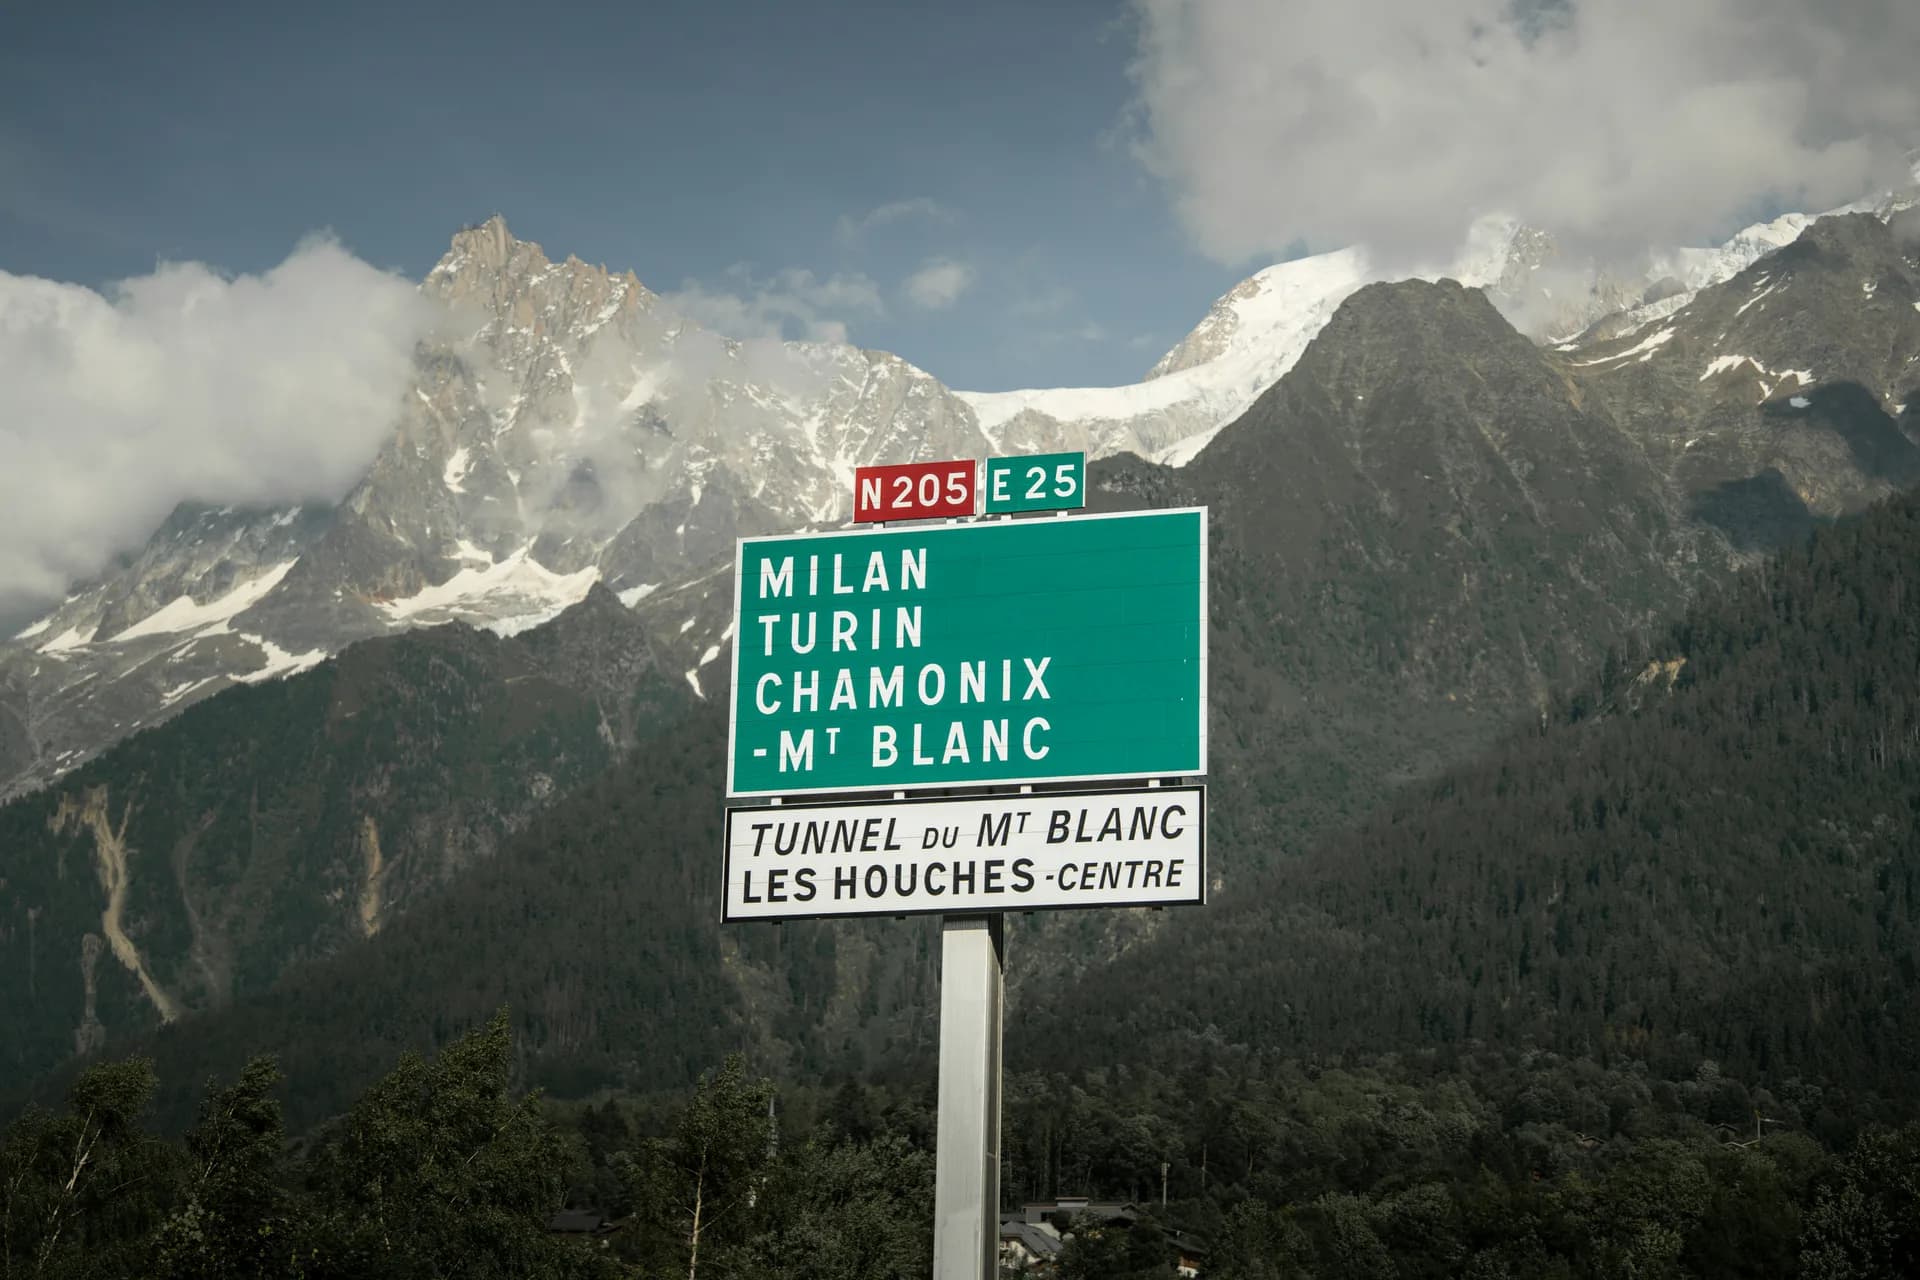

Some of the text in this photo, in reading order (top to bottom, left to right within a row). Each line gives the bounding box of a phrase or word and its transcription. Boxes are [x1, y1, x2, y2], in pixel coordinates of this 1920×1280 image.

[861, 471, 968, 511] N 205
[992, 463, 1077, 502] E 25
[759, 547, 927, 599] MILAN
[758, 605, 922, 657] TURIN
[755, 656, 1052, 715] CHAMONIX
[872, 716, 1051, 768] BLANC
[751, 817, 901, 857] TUNNEL
[921, 826, 959, 850] DU
[1046, 804, 1187, 844] BLANC
[743, 867, 817, 904] LES
